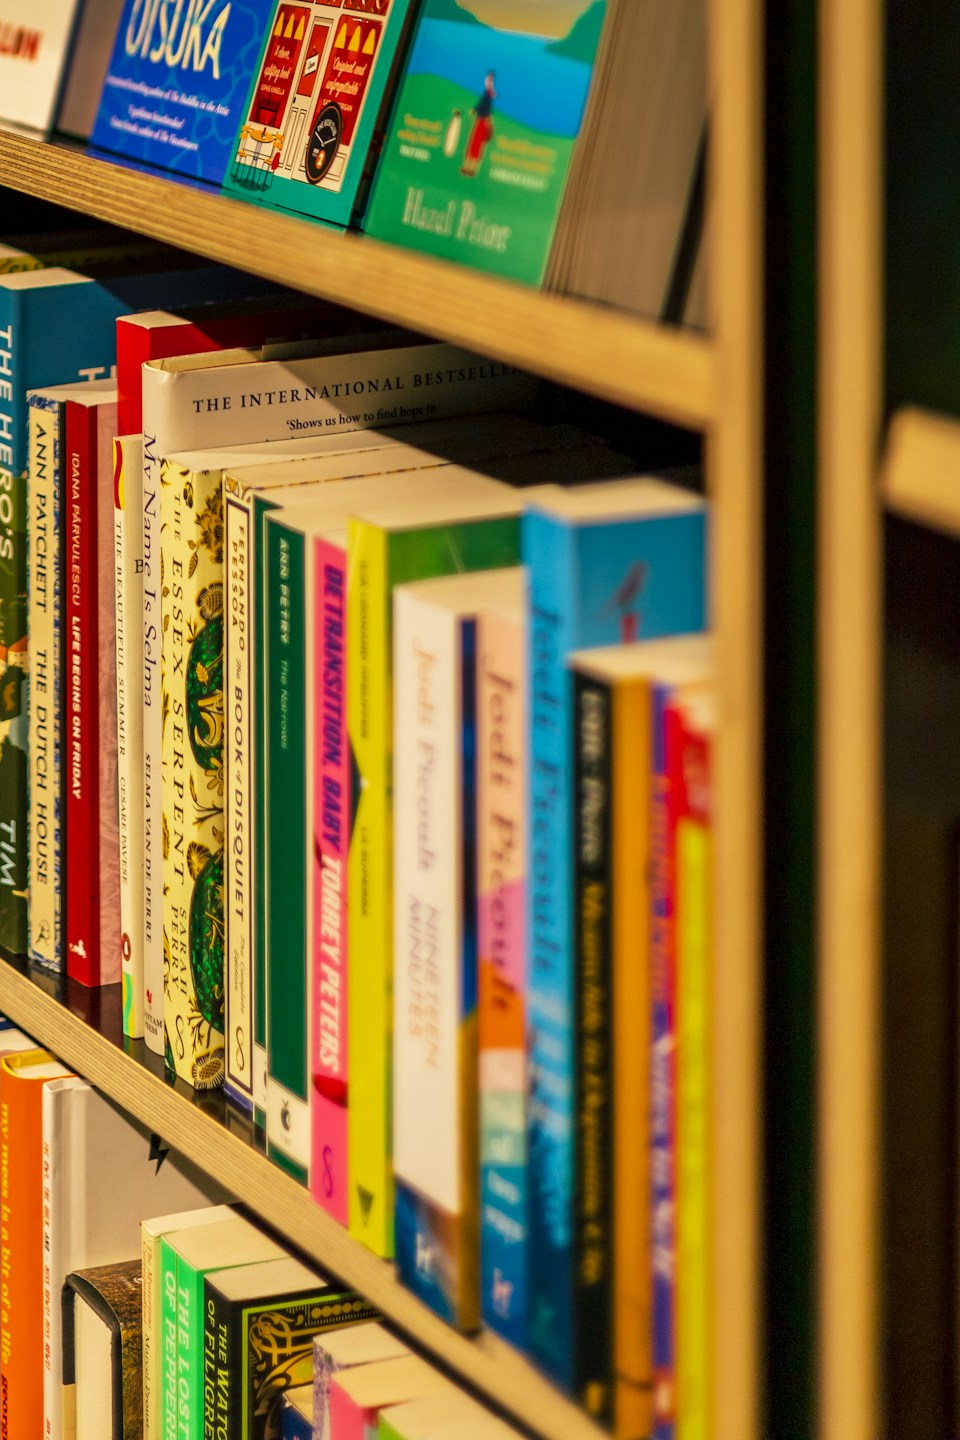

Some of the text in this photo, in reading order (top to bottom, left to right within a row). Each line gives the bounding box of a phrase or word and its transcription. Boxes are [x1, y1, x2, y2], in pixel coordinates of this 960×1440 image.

[400, 185, 513, 253] Hazel Prior
[193, 396, 233, 415] THE
[240, 375, 406, 410] INTERNATIONAL
[324, 417, 338, 428] us
[338, 411, 362, 427] how
[362, 412, 376, 425] to
[376, 406, 398, 422] find
[398, 405, 425, 424] hope
[425, 404, 439, 416] in
[71, 452, 82, 499] IOANA
[144, 488, 157, 578] Name
[144, 588, 157, 613] Is
[231, 539, 239, 628] PESSOA
[238, 525, 246, 652] FERNANDO
[72, 615, 82, 652] LIFE
[116, 566, 124, 670] BEAUTIFUL
[279, 537, 289, 751] ANN PETRY The Narrows
[36, 423, 48, 886] ANN PATCHETT THE DUTCH HOUSE
[72, 653, 82, 713] BEGINS
[144, 620, 157, 708] Selma
[235, 658, 244, 681] The
[118, 678, 126, 759] SUMMER
[172, 492, 186, 887] THE ESSEX SERPENT
[483, 651, 518, 788] Jodi
[72, 714, 82, 739] ON
[234, 684, 244, 767] BOOK
[72, 741, 82, 801] FRIDAY
[145, 817, 153, 849] VAN
[319, 562, 344, 1074] DETRANSITION, BABY TORREY PETERS
[0, 819, 17, 887] TIM
[120, 834, 128, 887] PAVESE
[145, 857, 153, 883] DE
[233, 788, 245, 922] DISQUIET
[145, 886, 153, 944] PERRE
[489, 812, 518, 1013] Picoult
[170, 902, 180, 990] PERRY
[179, 904, 188, 998] SARAH
[1, 1101, 10, 1140] my
[1, 1143, 10, 1199] mess
[1, 1202, 11, 1224] is
[1, 1226, 9, 1242] a
[1, 1245, 11, 1280] bit
[165, 1269, 178, 1313] OF
[1, 1283, 11, 1311] of
[1, 1309, 10, 1325] a
[1, 1329, 12, 1365] life
[178, 1286, 191, 1440] THE LOST
